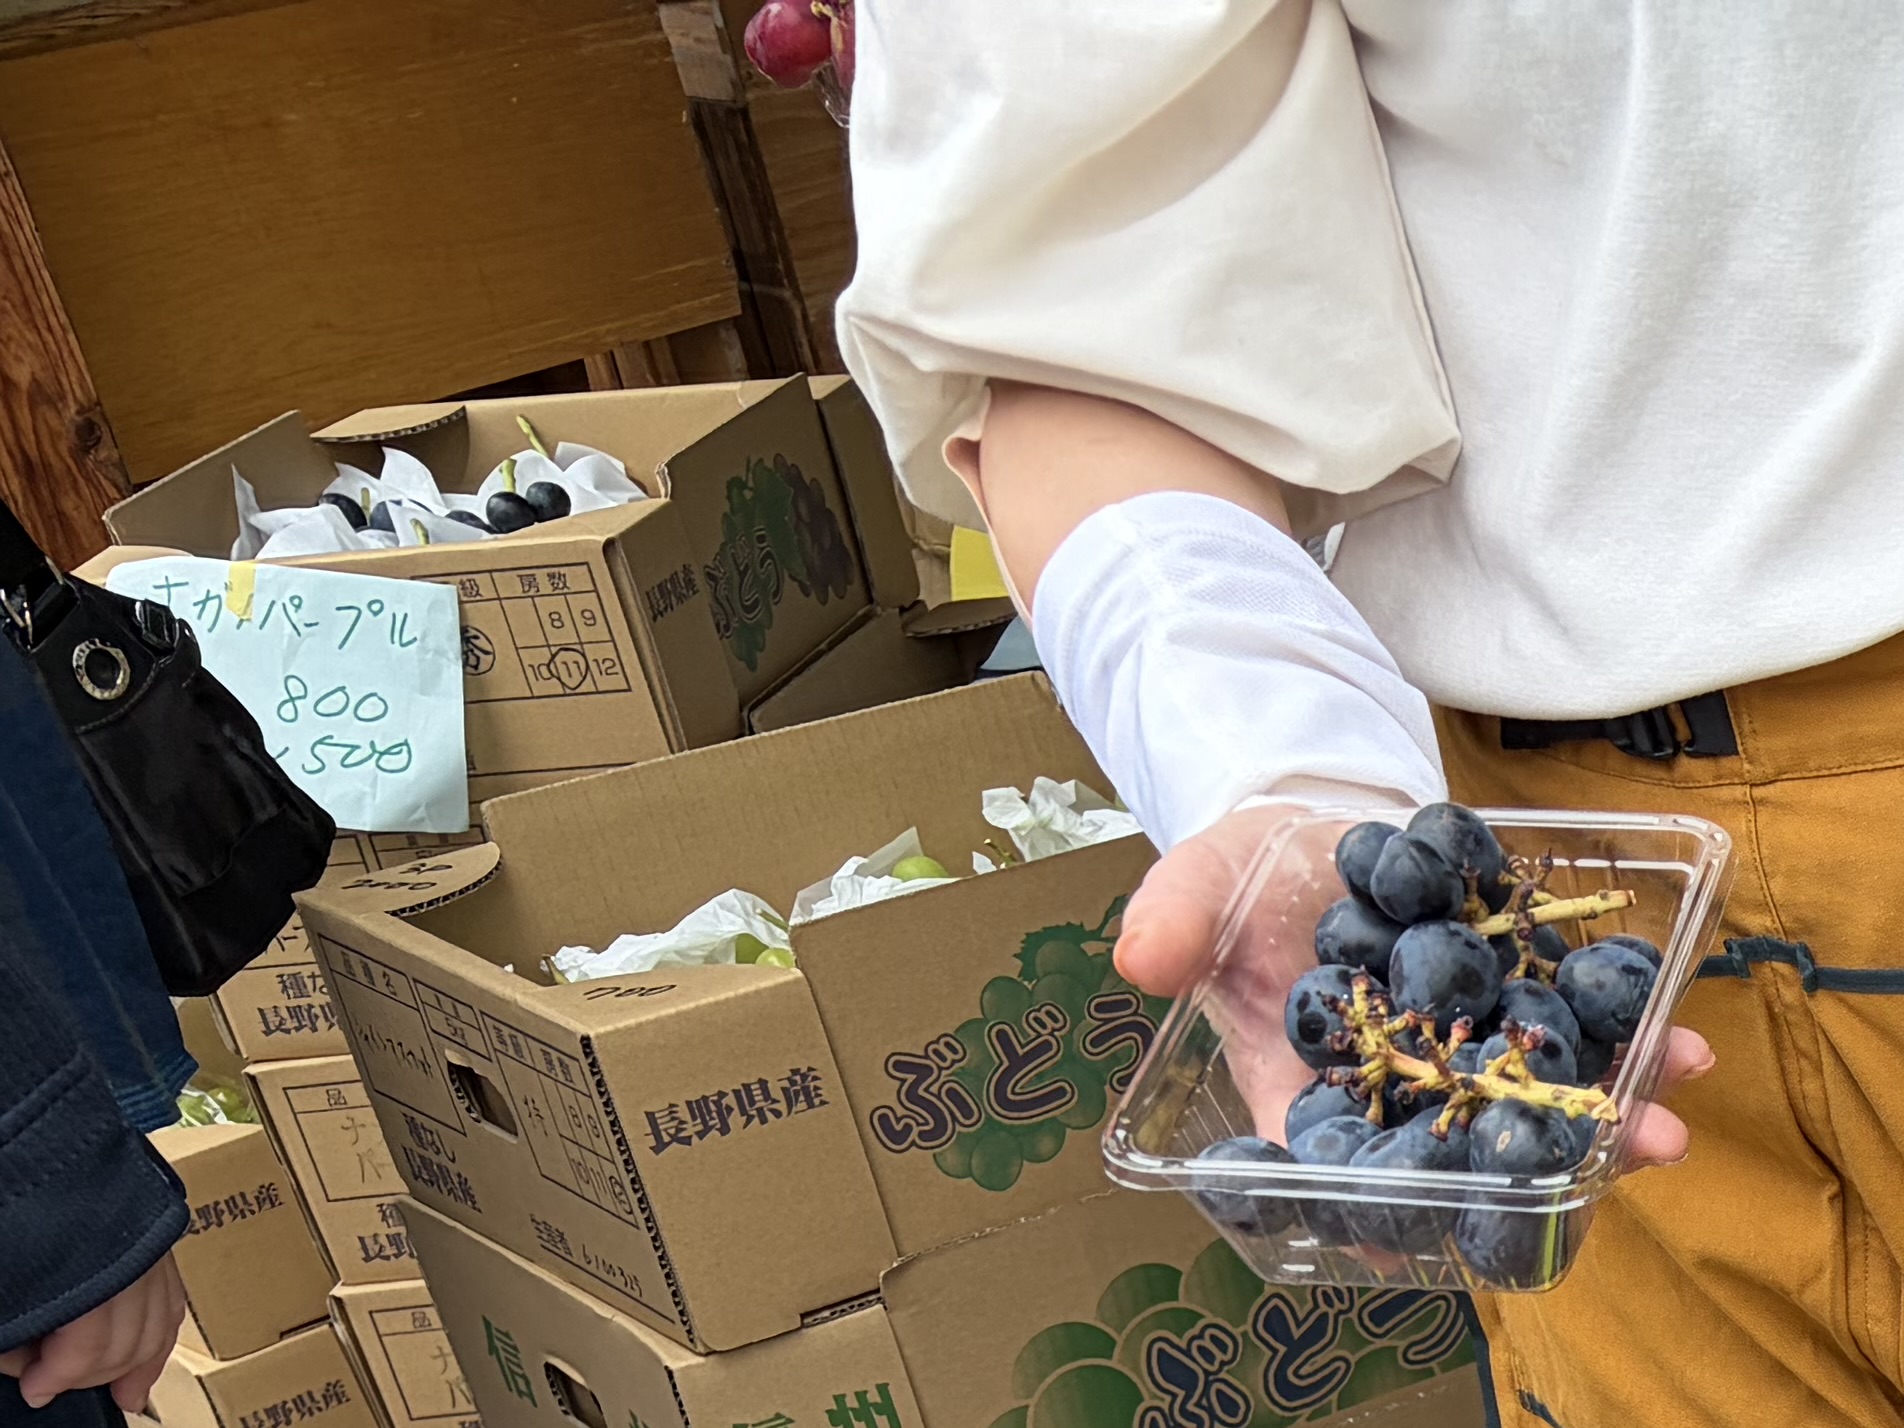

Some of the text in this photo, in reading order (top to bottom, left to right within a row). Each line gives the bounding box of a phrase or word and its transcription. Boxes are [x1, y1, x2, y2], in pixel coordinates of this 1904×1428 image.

[516, 570, 570, 594] 房数
[645, 563, 699, 623] 長野県産
[549, 612, 565, 630] 8
[581, 608, 597, 627] 9
[528, 662, 551, 681] 10
[592, 657, 618, 677] 12
[643, 1065, 830, 1157] 長野県産
